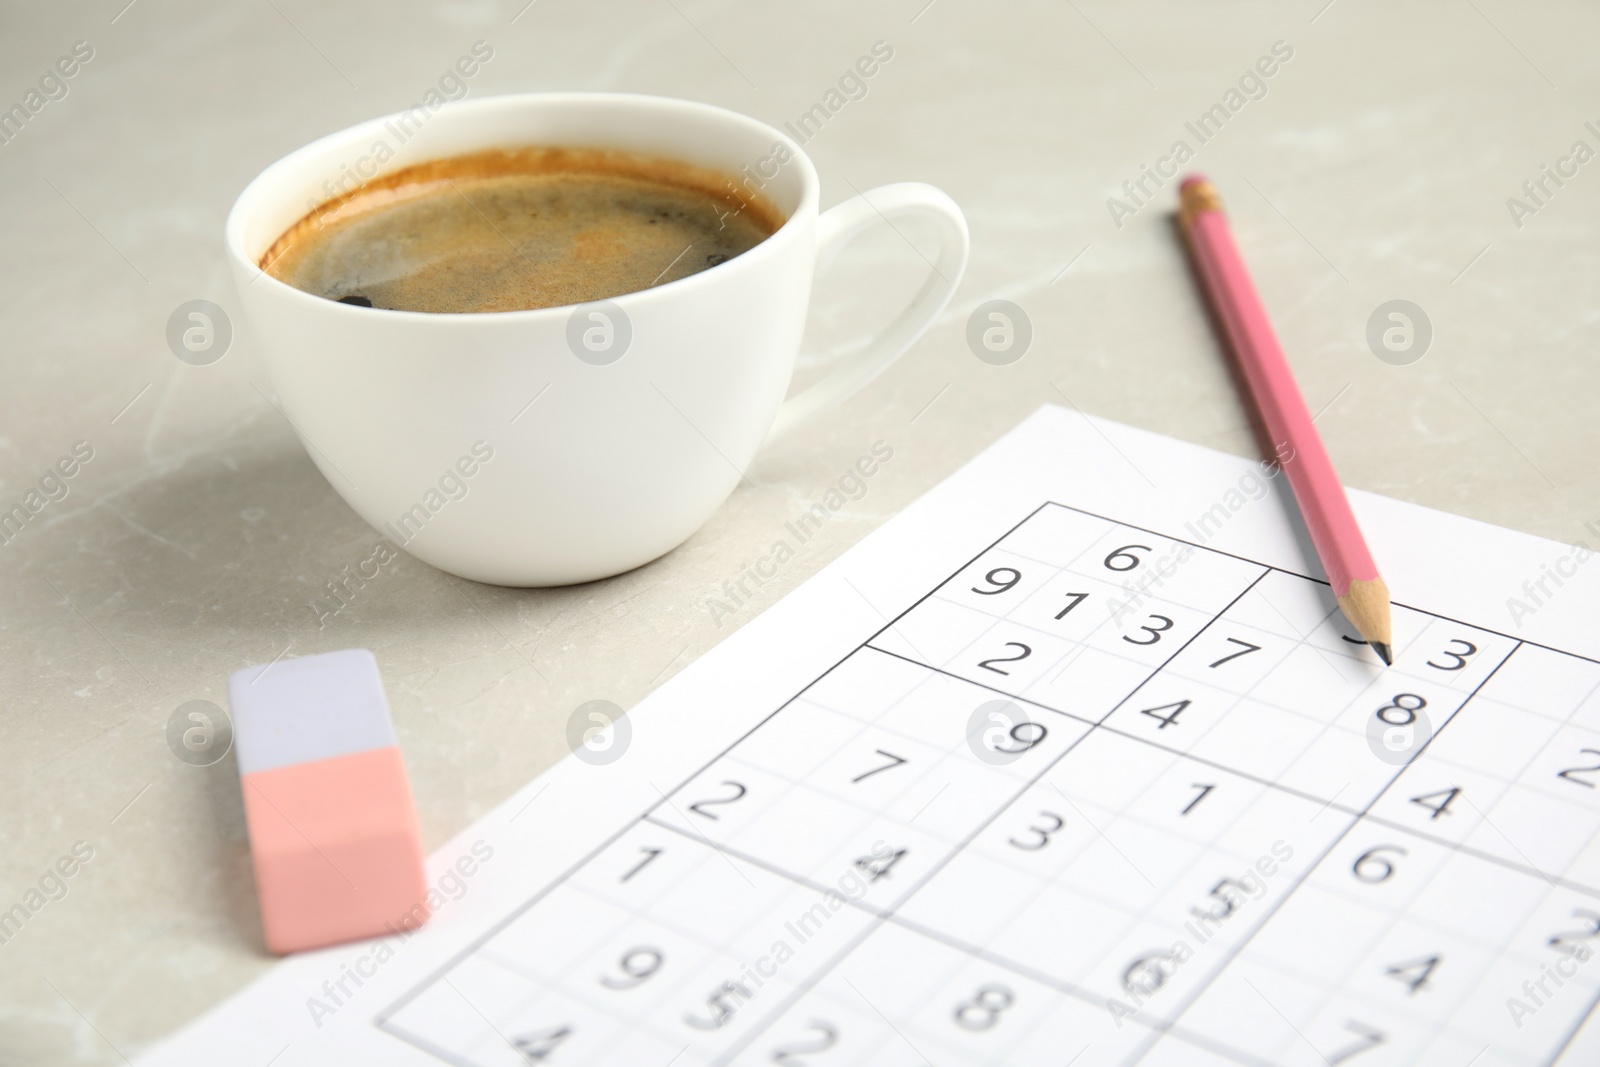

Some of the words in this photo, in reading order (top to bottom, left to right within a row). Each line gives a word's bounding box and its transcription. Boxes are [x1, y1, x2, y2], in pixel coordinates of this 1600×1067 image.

[1103, 544, 1152, 572] 6
[971, 567, 1022, 595] 9
[1053, 592, 1090, 620] 1
[1122, 614, 1174, 645] 3
[977, 642, 1032, 676] 2
[1208, 638, 1262, 669] 7
[1426, 639, 1477, 671] 3
[1140, 699, 1192, 729] 4
[1376, 693, 1428, 726] 8
[994, 722, 1048, 753] 9
[851, 749, 908, 783] 7
[1556, 749, 1600, 788] 2
[688, 781, 747, 820] 2
[1180, 783, 1216, 816] 1
[1409, 786, 1463, 821] 4
[1009, 811, 1065, 851] 3
[619, 847, 664, 883] 1
[1352, 844, 1408, 884] 6
[598, 945, 664, 990] 9
[1385, 952, 1444, 996] 4
[952, 983, 1016, 1032] 8
[1328, 1018, 1390, 1067] 7
